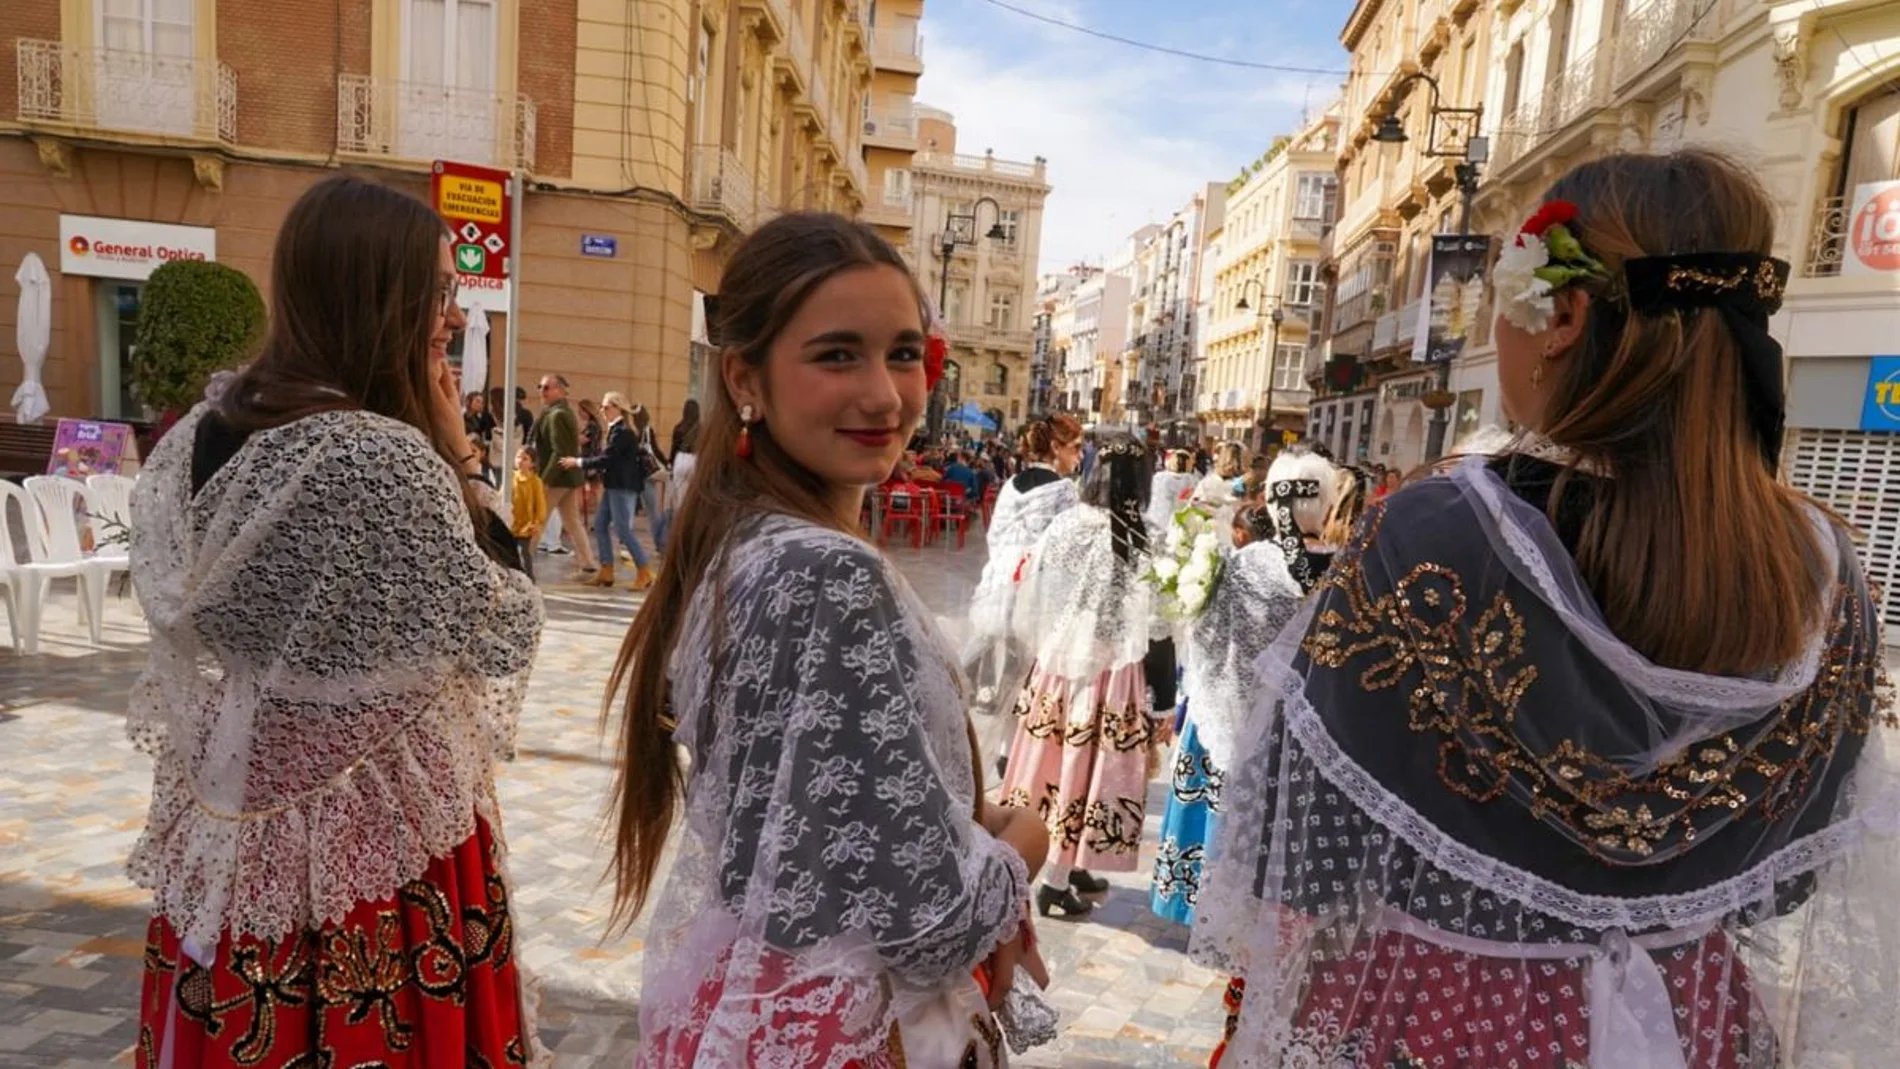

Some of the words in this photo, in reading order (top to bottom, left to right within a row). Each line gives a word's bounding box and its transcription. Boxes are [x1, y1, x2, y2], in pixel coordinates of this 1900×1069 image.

[474, 184, 485, 194] DE
[443, 202, 500, 218] EMERGENCIAS
[93, 240, 153, 258] General
[157, 246, 205, 262] Optica
